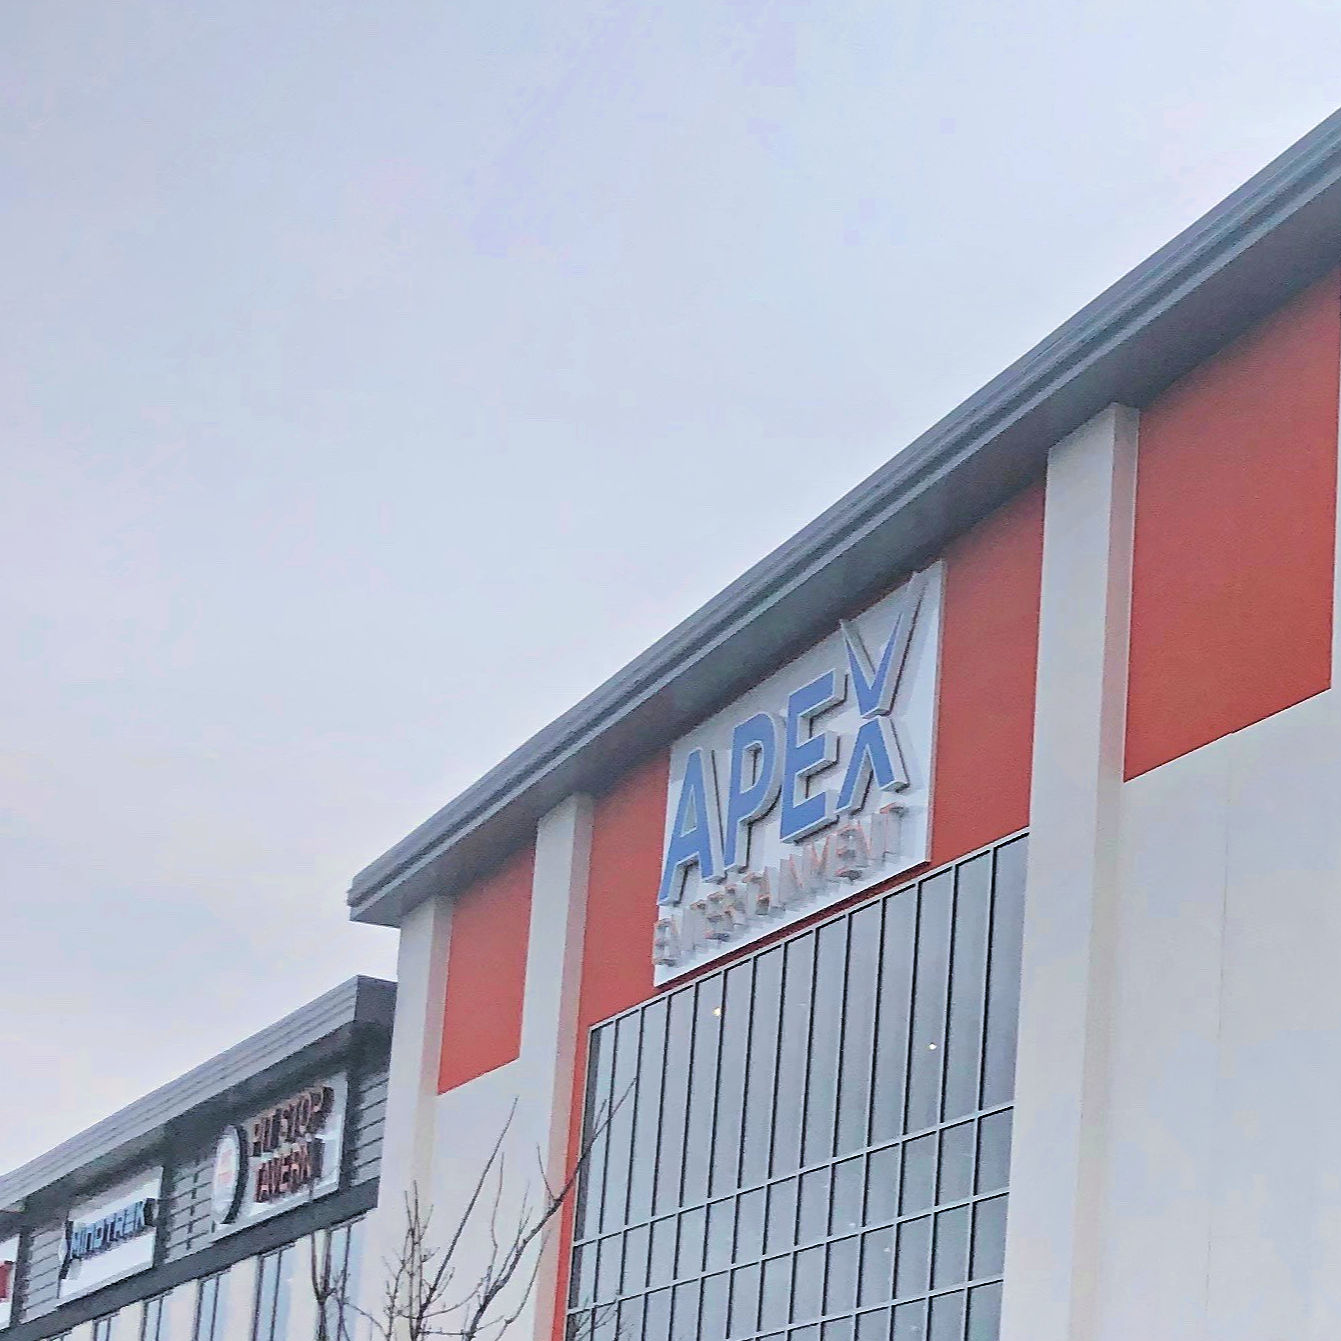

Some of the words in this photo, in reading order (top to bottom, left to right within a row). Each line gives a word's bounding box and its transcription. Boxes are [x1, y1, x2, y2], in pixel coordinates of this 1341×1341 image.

[658, 577, 917, 908] APEX
[280, 1085, 334, 1142] STOP
[255, 1137, 323, 1203] TAVERN
